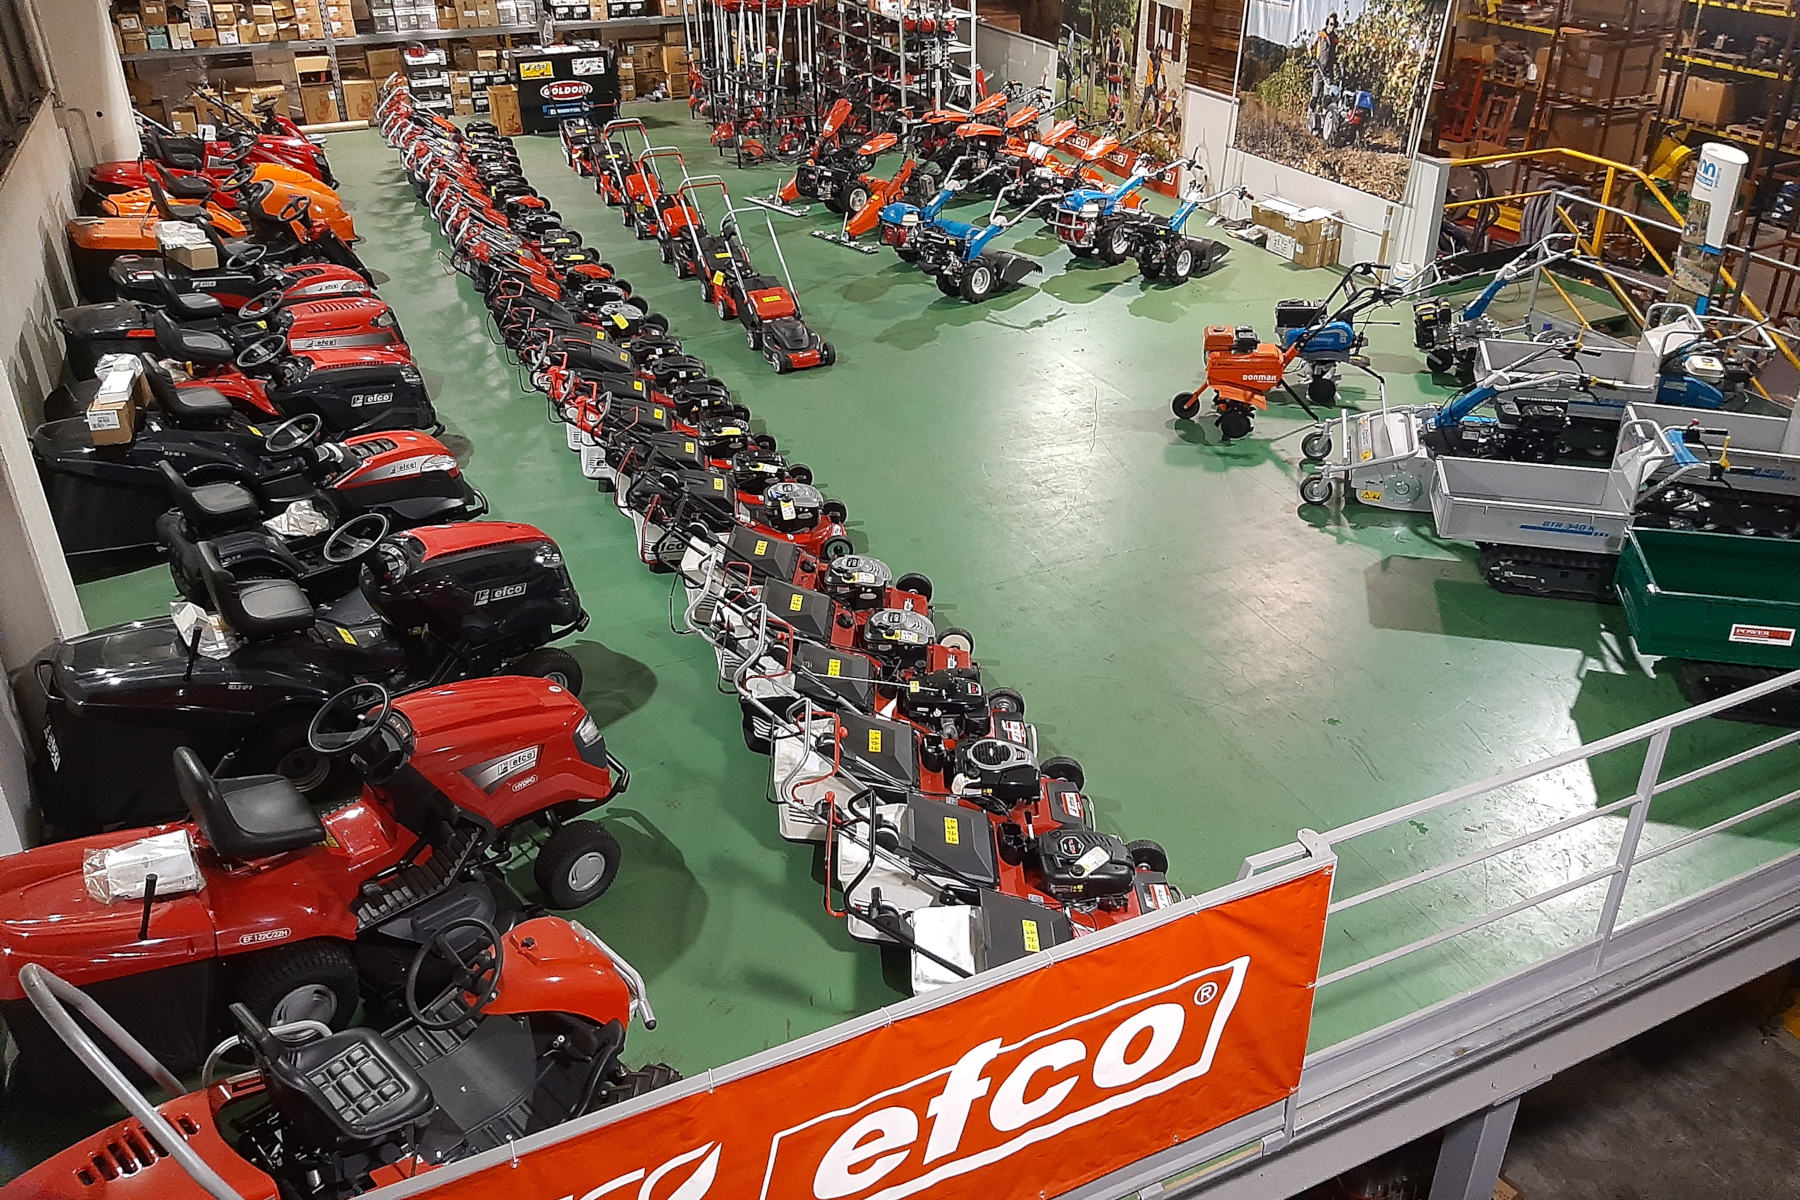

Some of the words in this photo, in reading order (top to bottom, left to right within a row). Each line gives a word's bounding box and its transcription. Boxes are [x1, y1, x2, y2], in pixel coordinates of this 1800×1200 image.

[367, 394, 389, 402] efco
[495, 585, 523, 598] efco
[512, 752, 533, 766] efco
[514, 776, 536, 790] HYDRO
[812, 1002, 1186, 1200] efco
